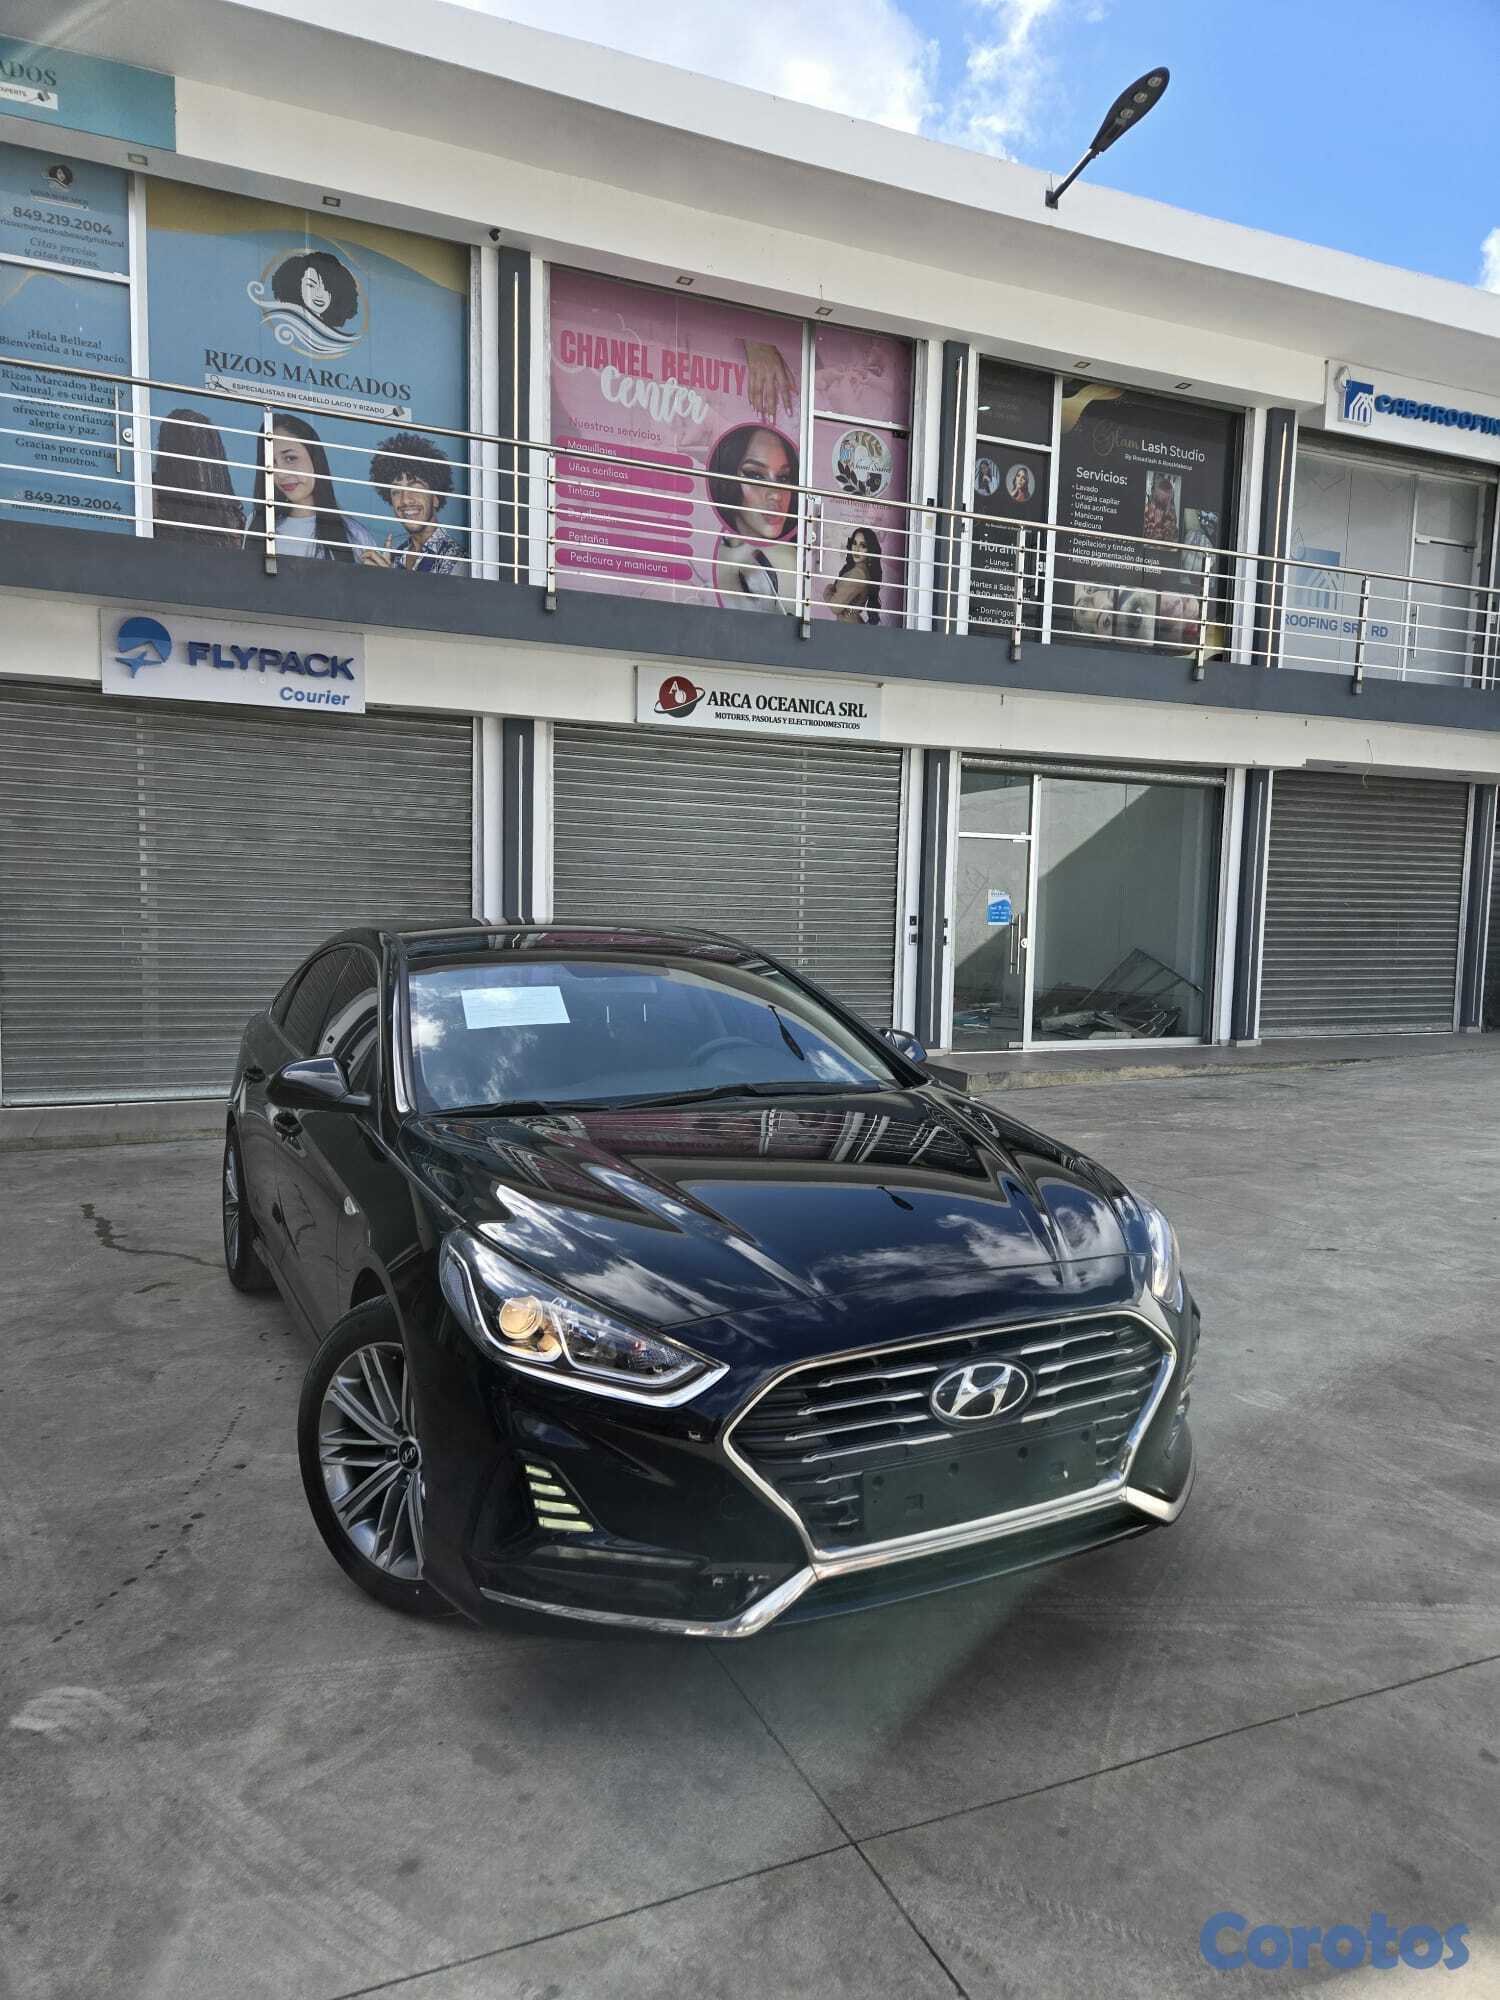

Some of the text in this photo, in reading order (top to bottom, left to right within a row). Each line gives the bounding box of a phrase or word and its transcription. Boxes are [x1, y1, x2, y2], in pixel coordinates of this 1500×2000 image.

[12, 206, 113, 236] 849.219.2004
[60, 334, 102, 349] Belleza!
[63, 348, 69, 356] a
[560, 330, 747, 396] CHANEL BEAUTY
[2, 369, 32, 382] Rizos
[35, 373, 87, 391] Marcados
[204, 349, 412, 401] RIZOS MARCADOS
[232, 383, 286, 398] ESPECIALISTAS
[298, 393, 330, 405] CABELLO
[331, 400, 352, 409] LACIO
[359, 404, 385, 414] RIZADO
[601, 364, 709, 424] Center
[13, 405, 60, 419] ofrecerte
[69, 424, 76, 434] y
[569, 417, 662, 442] Nuestros servicios
[15, 438, 56, 451] Gracias
[59, 445, 78, 454] por
[1141, 439, 1168, 455] Lash
[1170, 446, 1205, 463] Studio
[34, 453, 48, 461] en
[1076, 466, 1128, 486] Servicios:
[24, 490, 122, 512] 849.219.2004
[567, 485, 600, 498] Tintado
[1074, 511, 1104, 521] Manicura
[568, 531, 609, 545] Pestañas
[570, 551, 669, 574] Pedicura y manicura
[989, 558, 1010, 568] Lunes
[1371, 625, 1389, 638] RD
[187, 640, 355, 681] FLYPACK
[280, 686, 350, 706] Courier
[707, 691, 868, 718] ARCA OCEANICA SRL
[715, 711, 750, 722] MOTORES,
[752, 714, 782, 725] PASOLAS
[788, 718, 860, 730] ELECTRODOMESTICOS
